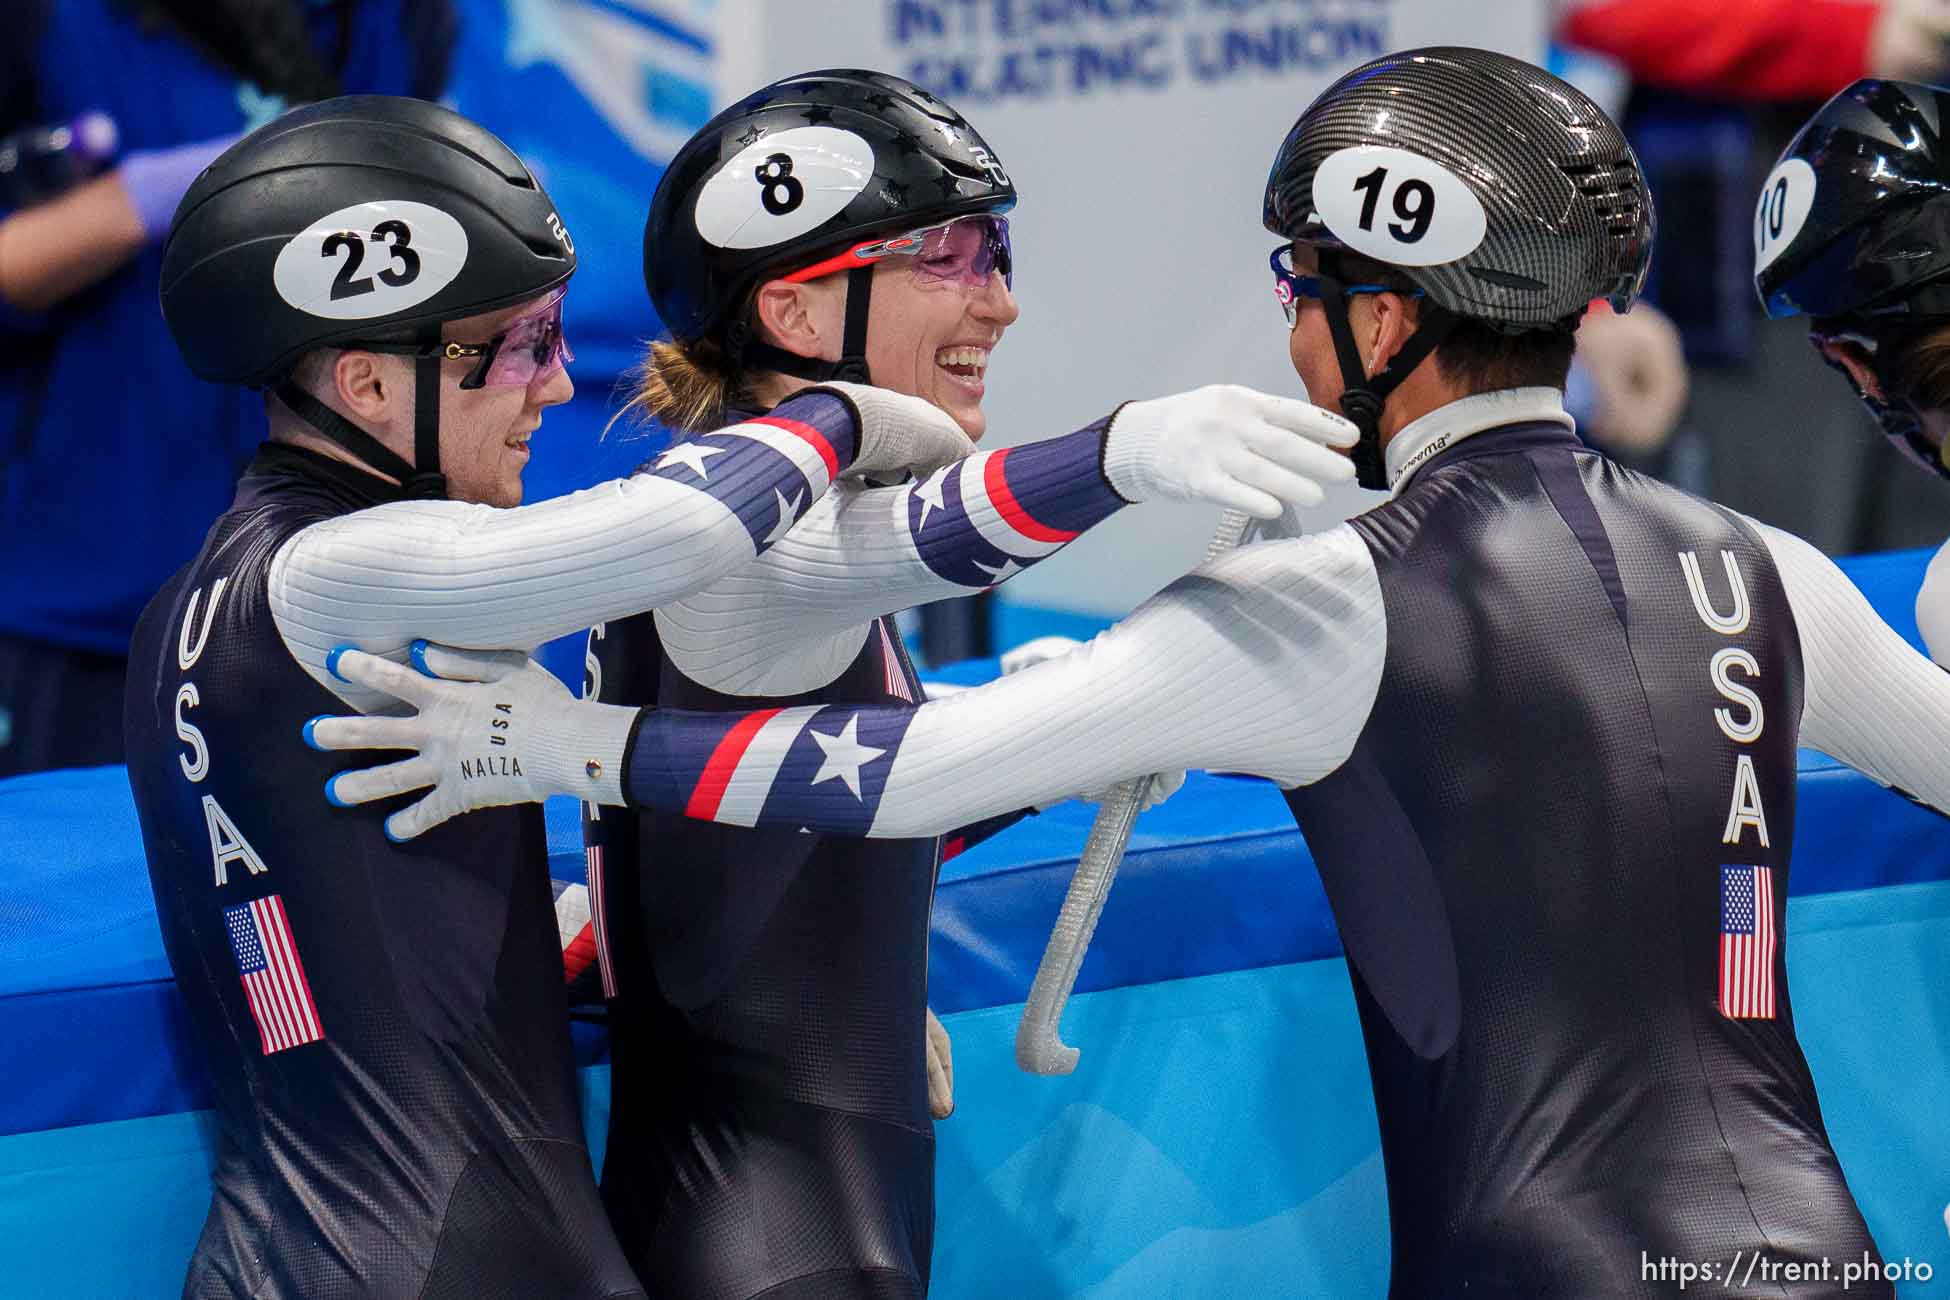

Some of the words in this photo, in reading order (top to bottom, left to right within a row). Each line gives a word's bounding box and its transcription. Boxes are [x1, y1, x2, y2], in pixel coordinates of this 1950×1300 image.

[906, 32, 1172, 104] SKATING
[1184, 18, 1386, 84] UNION
[754, 152, 804, 216] 8
[1353, 165, 1435, 244] 19
[1760, 176, 1788, 252] 10
[320, 219, 421, 301] 23
[174, 575, 269, 887] USA
[489, 703, 513, 746] USA
[1677, 549, 1771, 849] USA
[460, 756, 524, 781] NALZA
